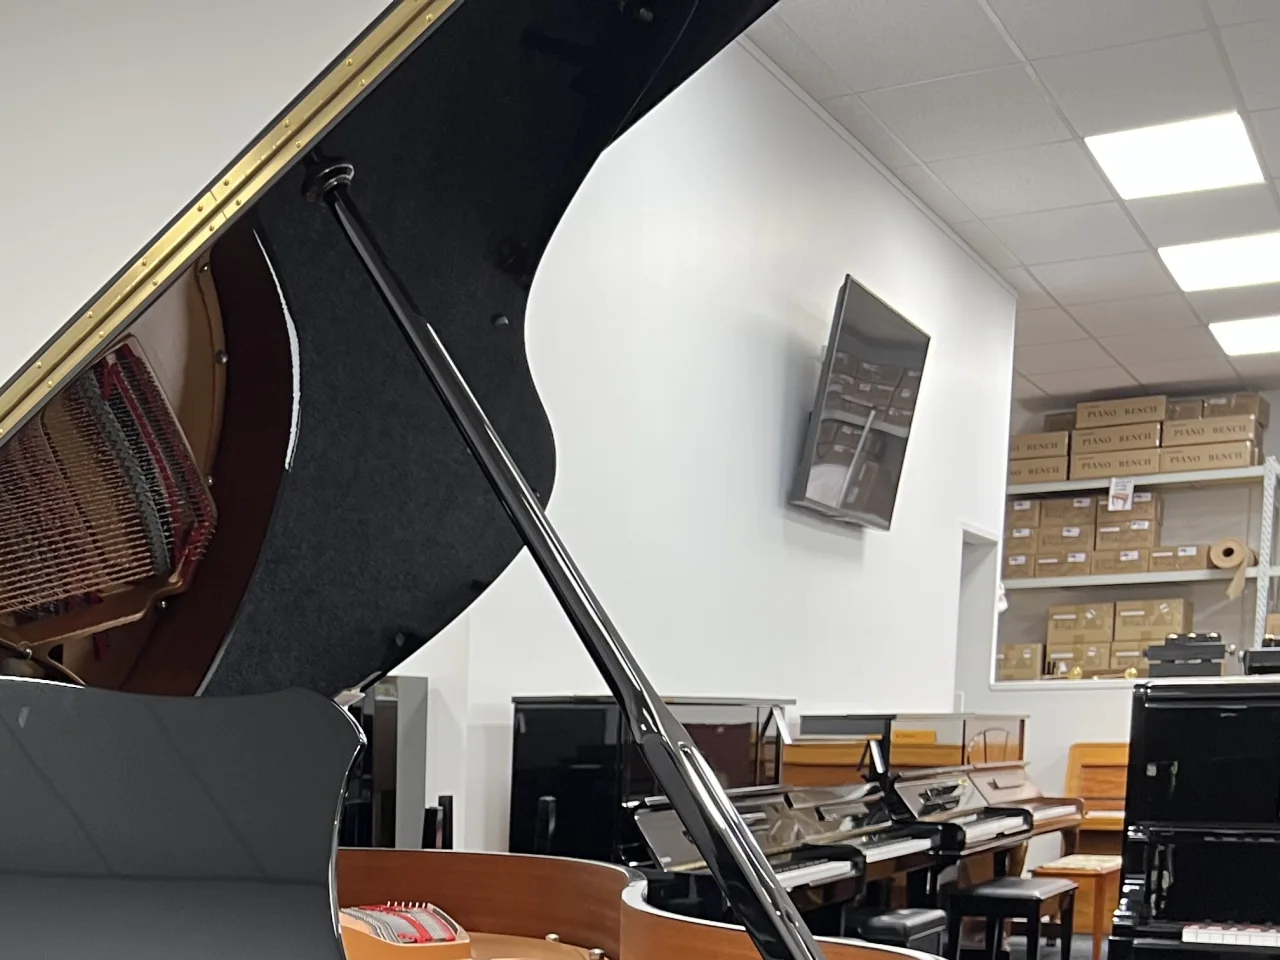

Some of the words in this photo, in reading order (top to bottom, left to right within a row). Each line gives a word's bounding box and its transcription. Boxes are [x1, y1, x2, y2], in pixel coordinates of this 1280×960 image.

[1087, 408, 1117, 419] PIANO
[1124, 405, 1157, 416] BENCH
[1174, 428, 1205, 438] PIANO
[1212, 425, 1247, 435] BENCH
[1082, 436, 1112, 446] PIANO
[1119, 432, 1151, 442] BENCH
[1081, 460, 1111, 470] PIANO
[1118, 458, 1151, 468] BENCH
[1170, 455, 1201, 465] PIANO
[1208, 452, 1242, 462] BENCH
[1028, 466, 1060, 476] BENCH
